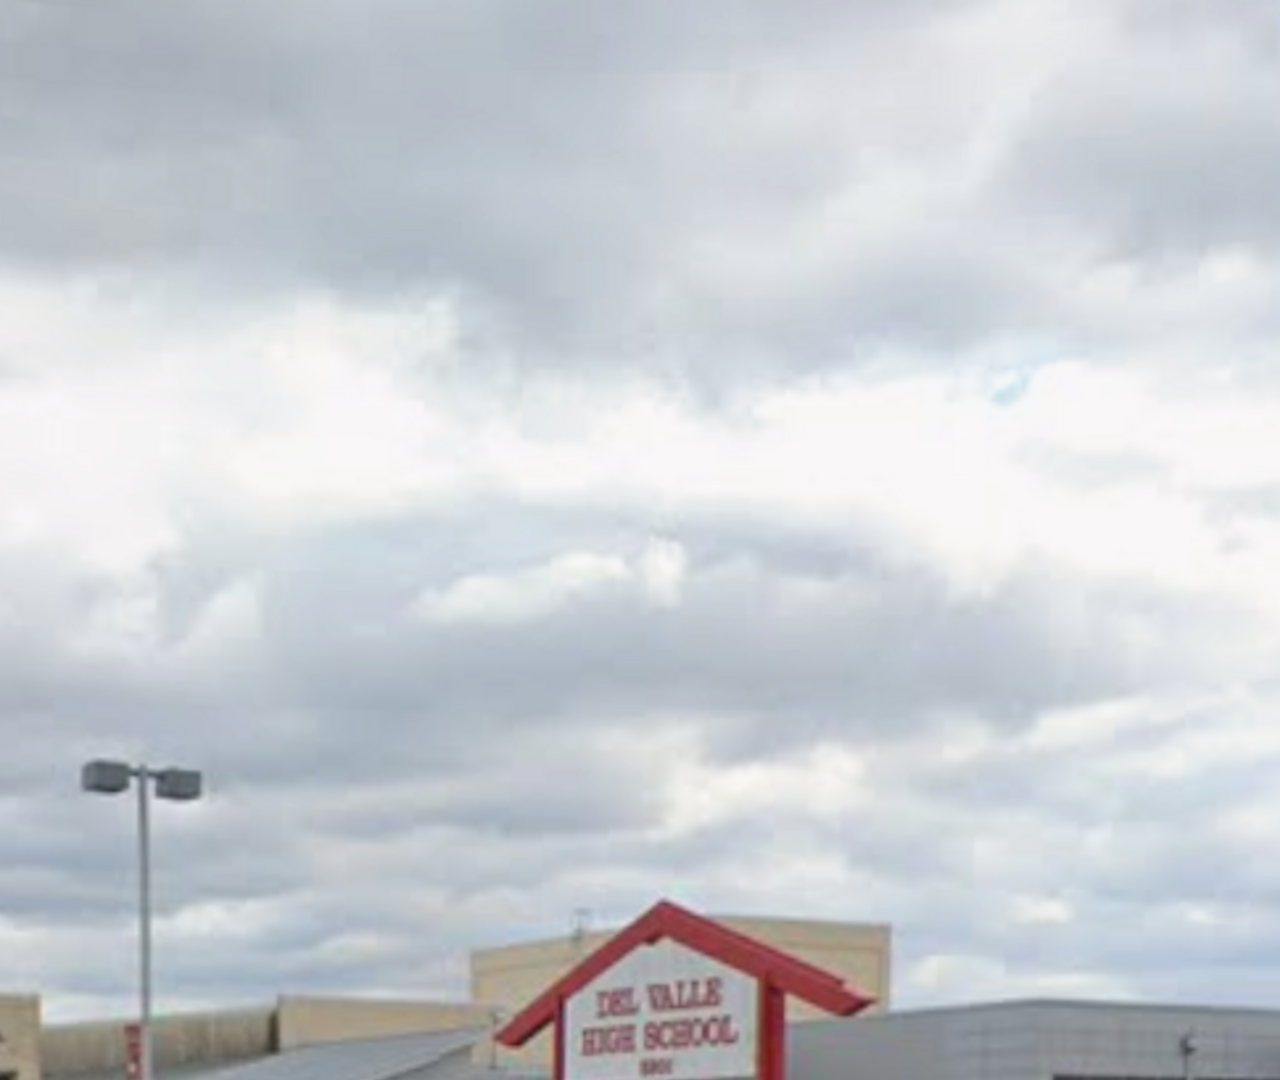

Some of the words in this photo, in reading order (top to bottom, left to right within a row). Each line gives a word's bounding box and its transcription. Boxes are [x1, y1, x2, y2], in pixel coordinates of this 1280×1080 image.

[596, 986, 639, 1018] DEL
[646, 977, 723, 1011] VALLE
[582, 1023, 637, 1056] HIGH
[644, 1015, 739, 1050] SCHOOL
